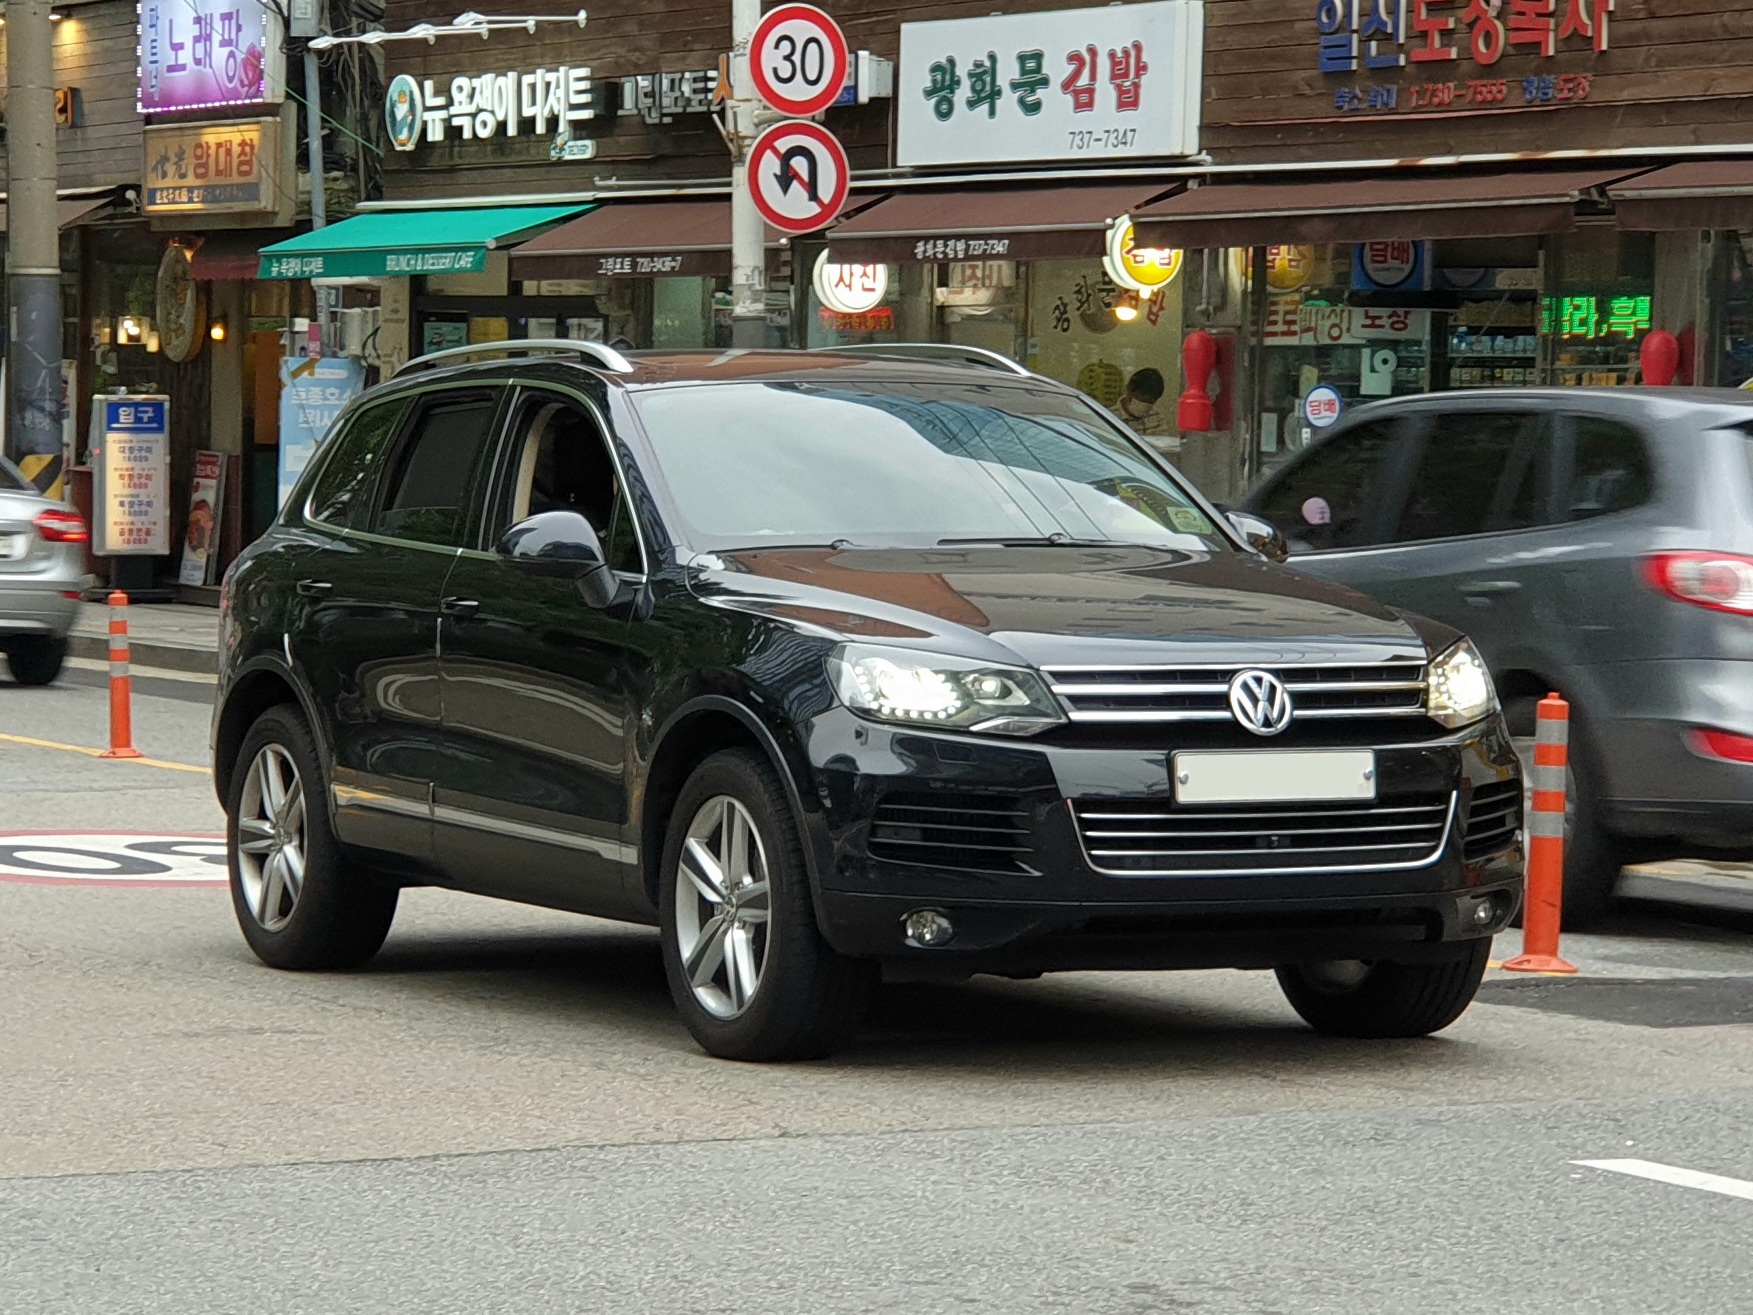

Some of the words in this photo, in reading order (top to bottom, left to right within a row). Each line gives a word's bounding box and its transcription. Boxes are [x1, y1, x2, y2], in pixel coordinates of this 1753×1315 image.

[166, 8, 243, 84] 노래팡
[772, 34, 824, 87] 30
[1068, 128, 1137, 150] 737-7347
[193, 138, 255, 179] 양대창
[118, 406, 155, 423] 입구
[1309, 399, 1337, 416] 담배
